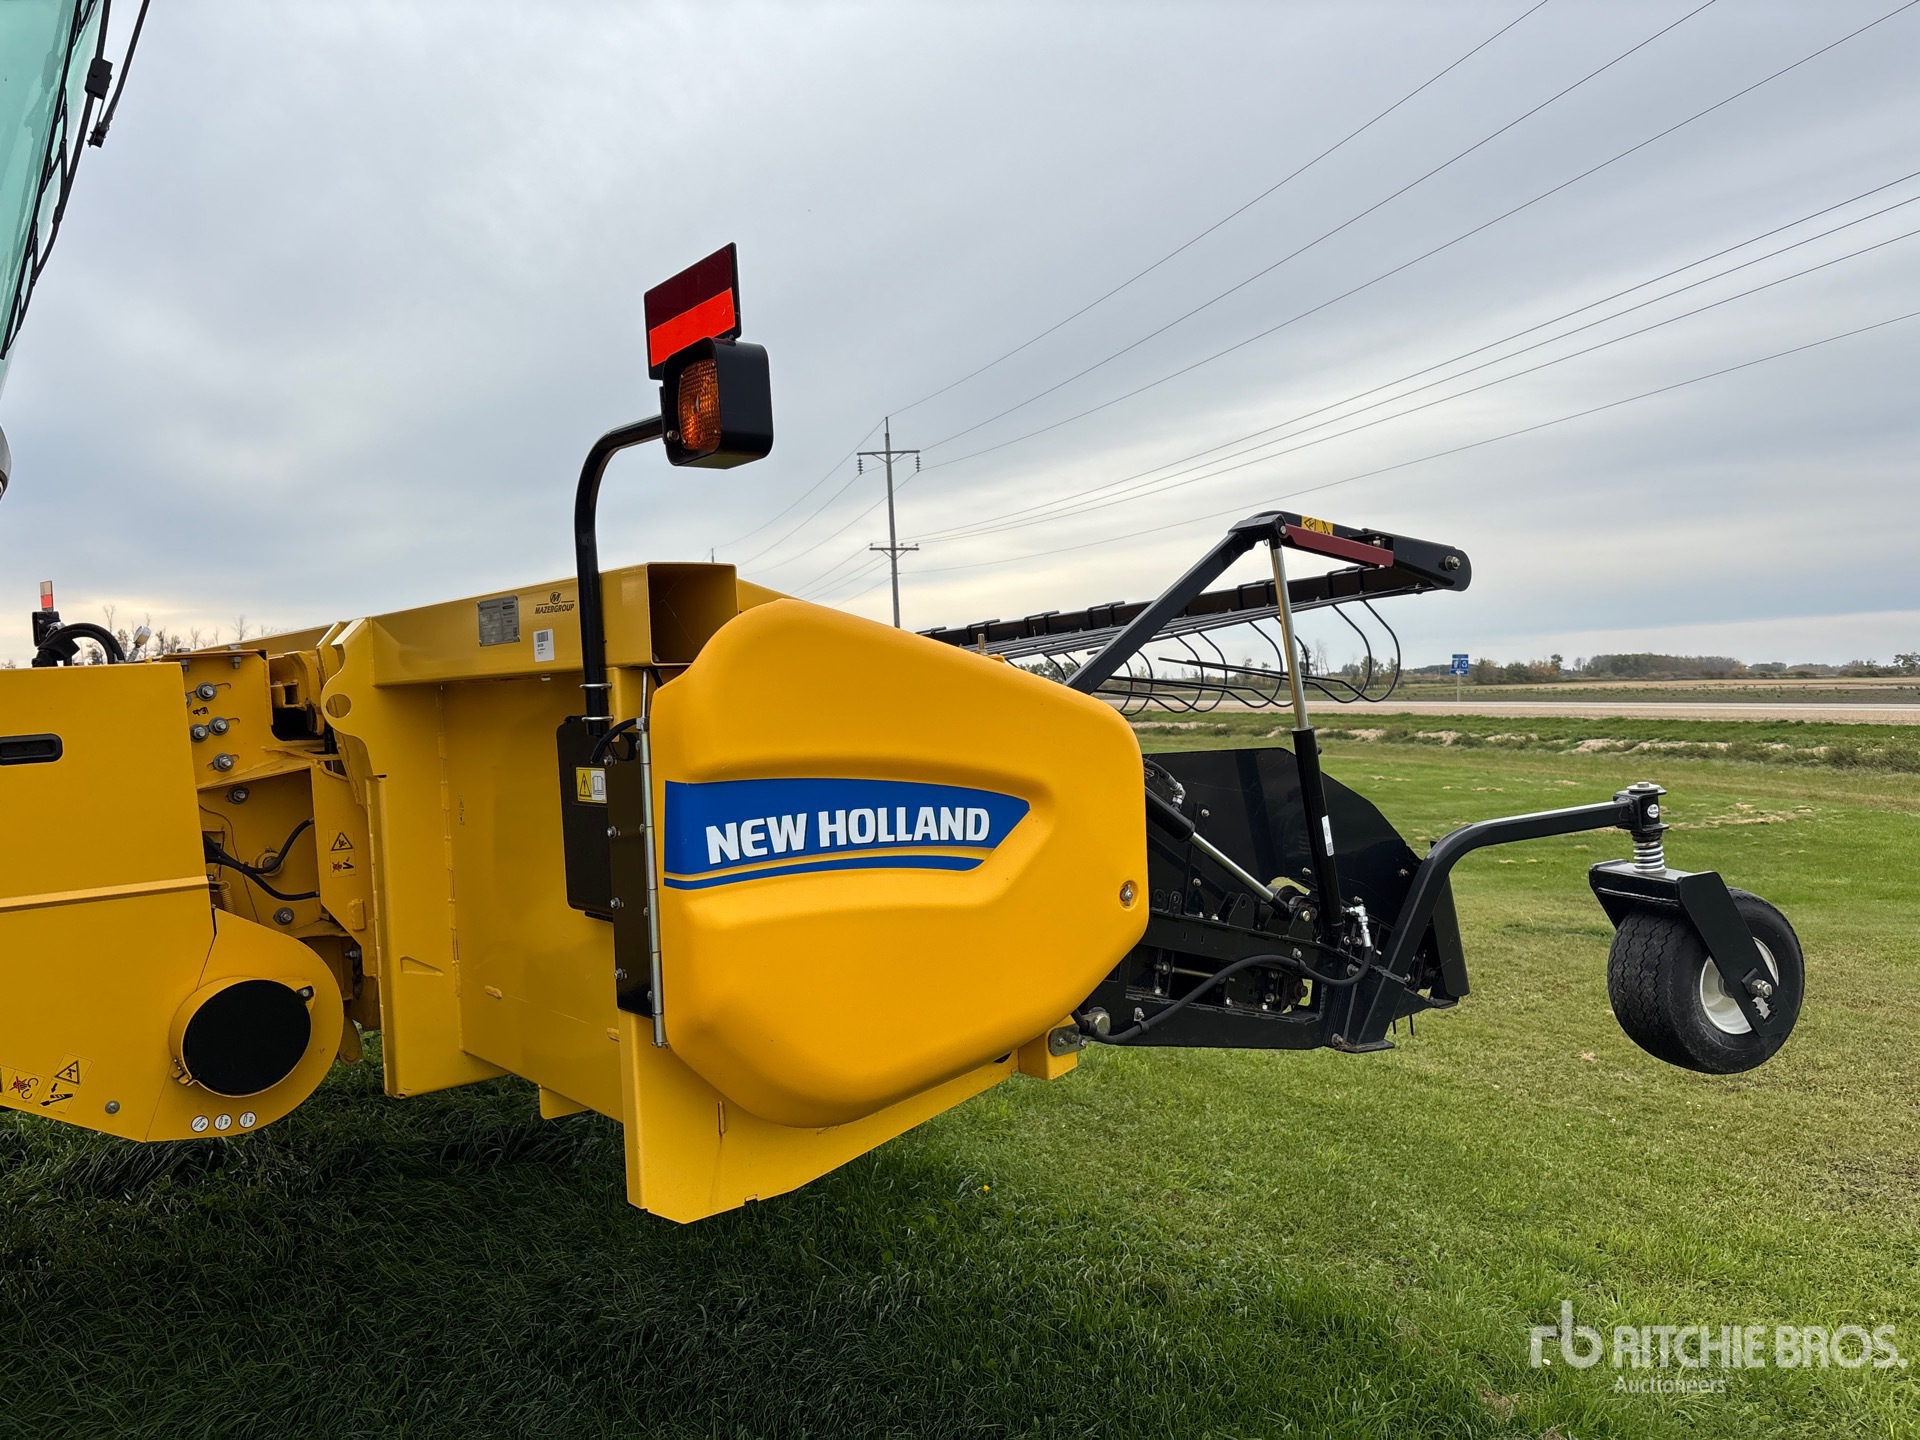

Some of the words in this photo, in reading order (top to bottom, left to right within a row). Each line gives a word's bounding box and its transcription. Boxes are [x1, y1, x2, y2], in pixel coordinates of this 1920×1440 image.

[534, 603, 575, 615] MAZERGROUP
[706, 813, 806, 864] NEW
[819, 807, 989, 847] HOLLAND
